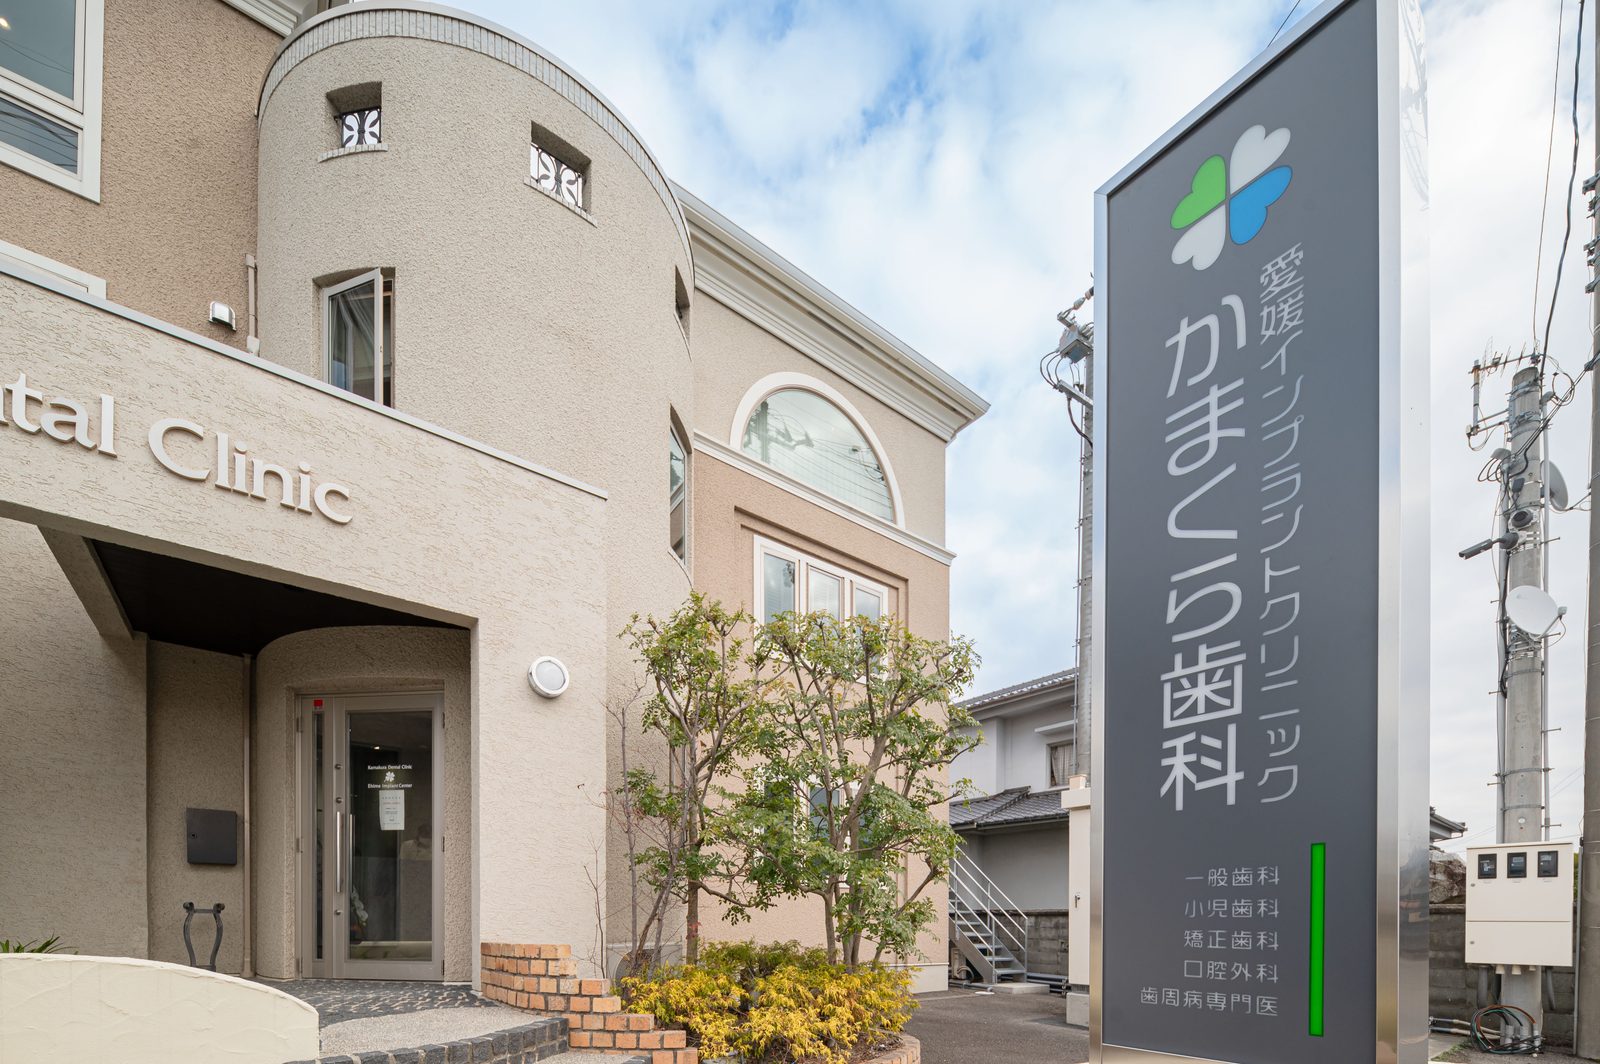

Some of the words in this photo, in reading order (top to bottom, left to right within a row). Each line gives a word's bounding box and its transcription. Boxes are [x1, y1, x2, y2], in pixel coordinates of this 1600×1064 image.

[148, 417, 353, 525] Clinic
[1259, 241, 1304, 804] 愛媛インプラントクリニック
[1160, 293, 1247, 812] かまくら歯科
[1185, 866, 1280, 887] 一般歯科
[1184, 898, 1280, 918] 小児歯科
[1184, 930, 1279, 950] 矯正歯科
[1184, 960, 1279, 984] 口腔外科
[1140, 986, 1278, 1017] 歯周病専門医
